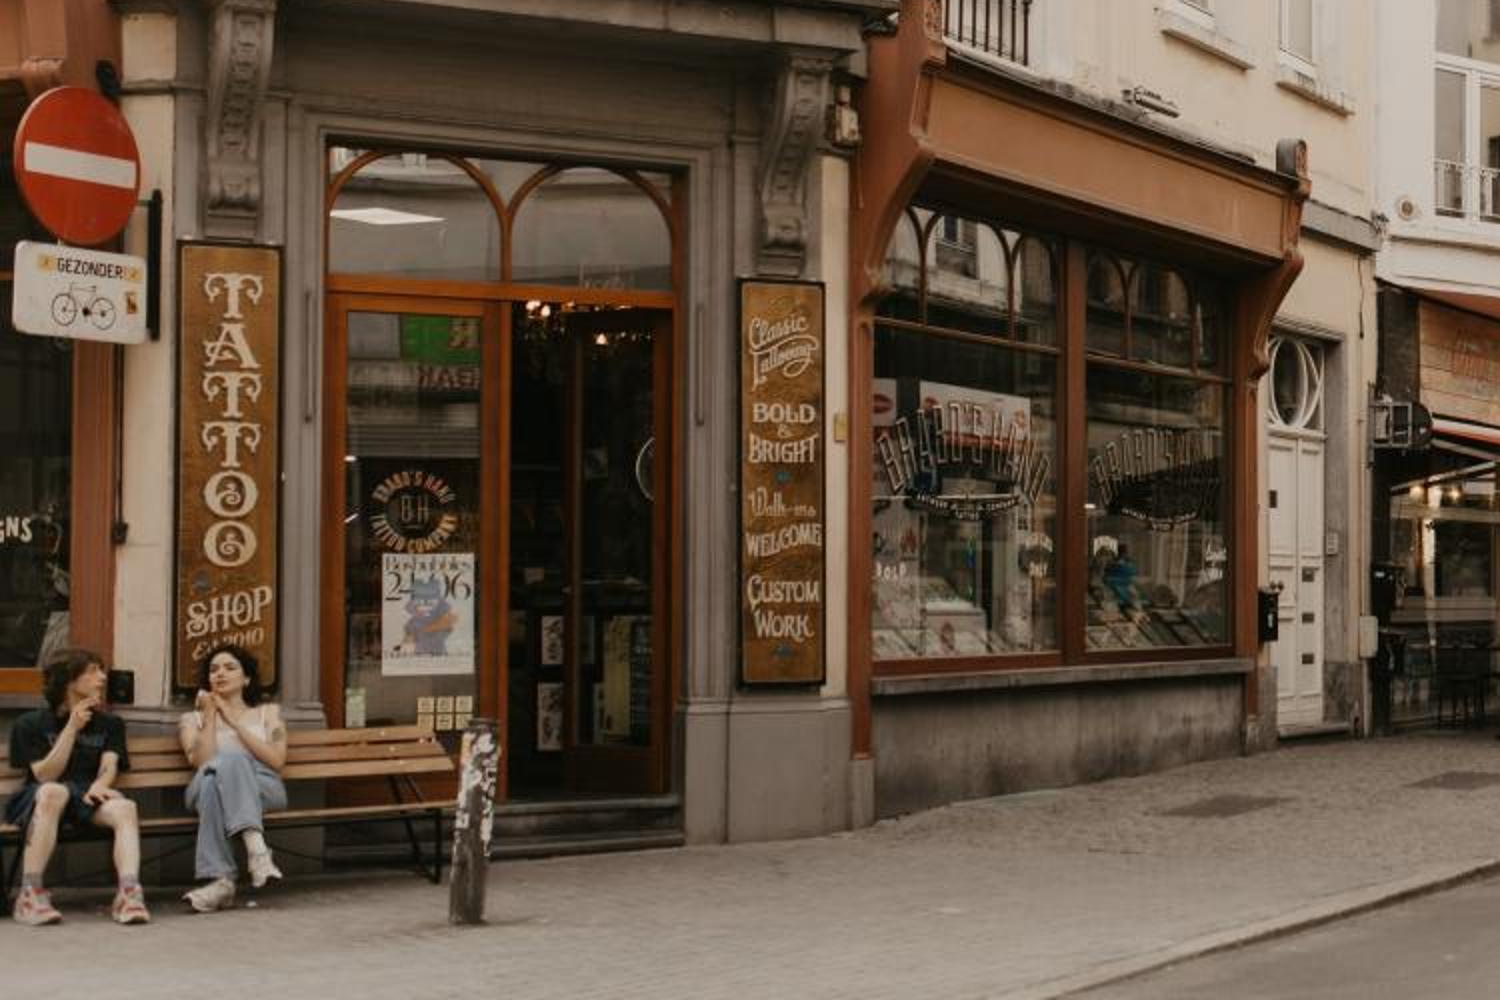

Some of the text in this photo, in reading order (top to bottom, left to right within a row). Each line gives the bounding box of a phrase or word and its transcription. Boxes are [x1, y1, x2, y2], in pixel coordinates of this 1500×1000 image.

[201, 272, 263, 567] TATTOO
[753, 403, 816, 423] BOLD
[750, 431, 818, 463] BRIGHT
[745, 522, 822, 558] WELCOME
[748, 574, 820, 611] CUSTOM
[186, 585, 273, 640] SHOP
[754, 609, 814, 643] WORK
